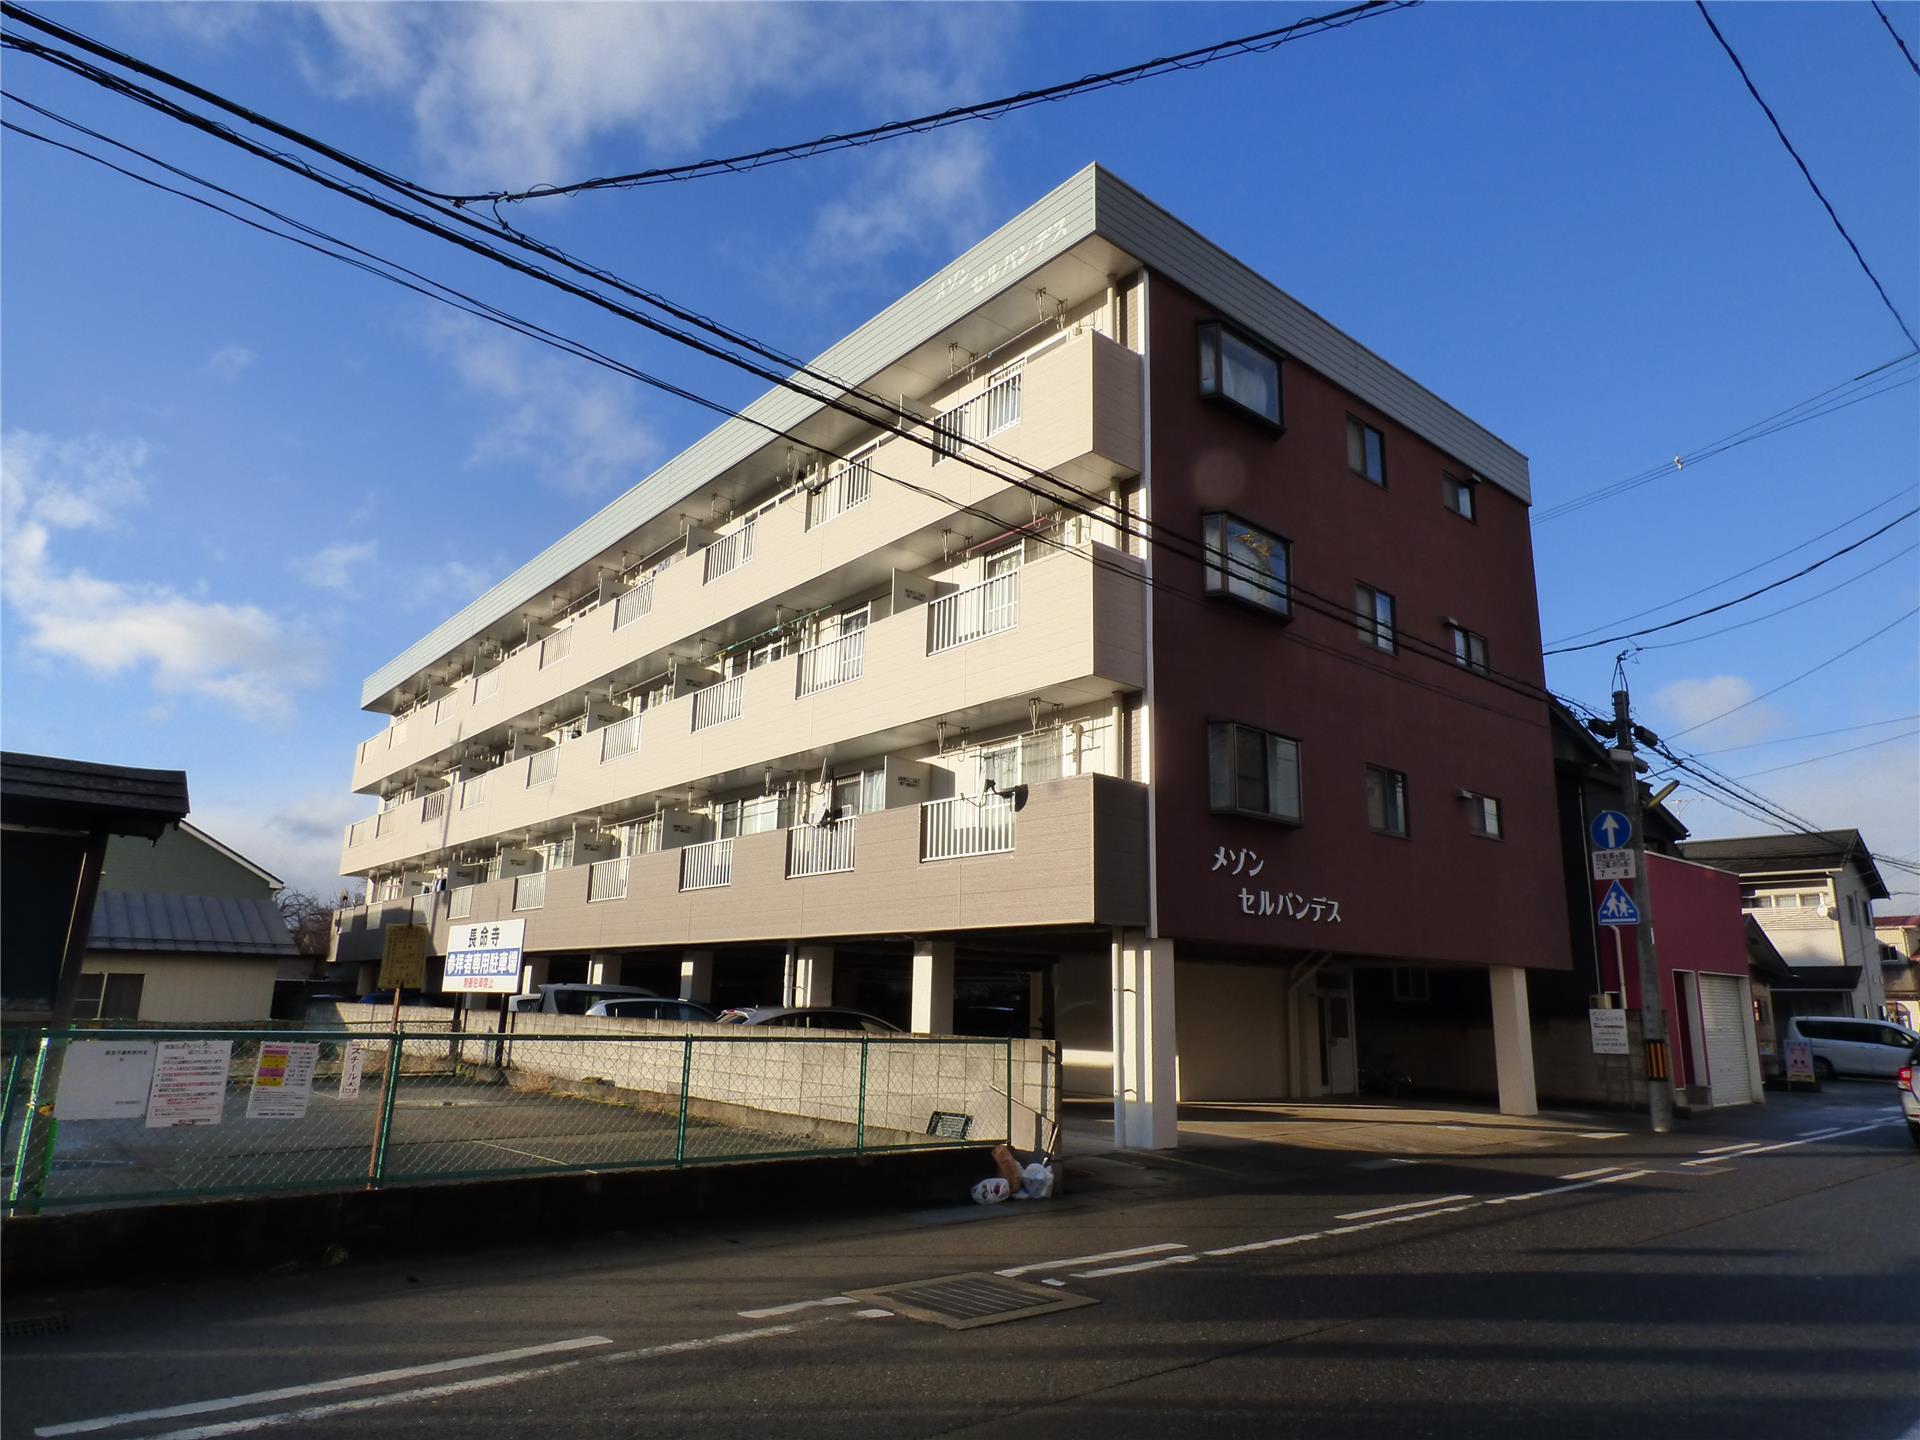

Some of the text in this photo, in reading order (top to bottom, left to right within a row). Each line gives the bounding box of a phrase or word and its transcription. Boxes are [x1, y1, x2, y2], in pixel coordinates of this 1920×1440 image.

[971, 217, 1067, 294] セルバンデス
[1211, 846, 1264, 877] メゾン
[1238, 887, 1342, 923] セルバンデス
[468, 926, 500, 948] 長命寺
[447, 951, 519, 975] 参拝者専用駐車場
